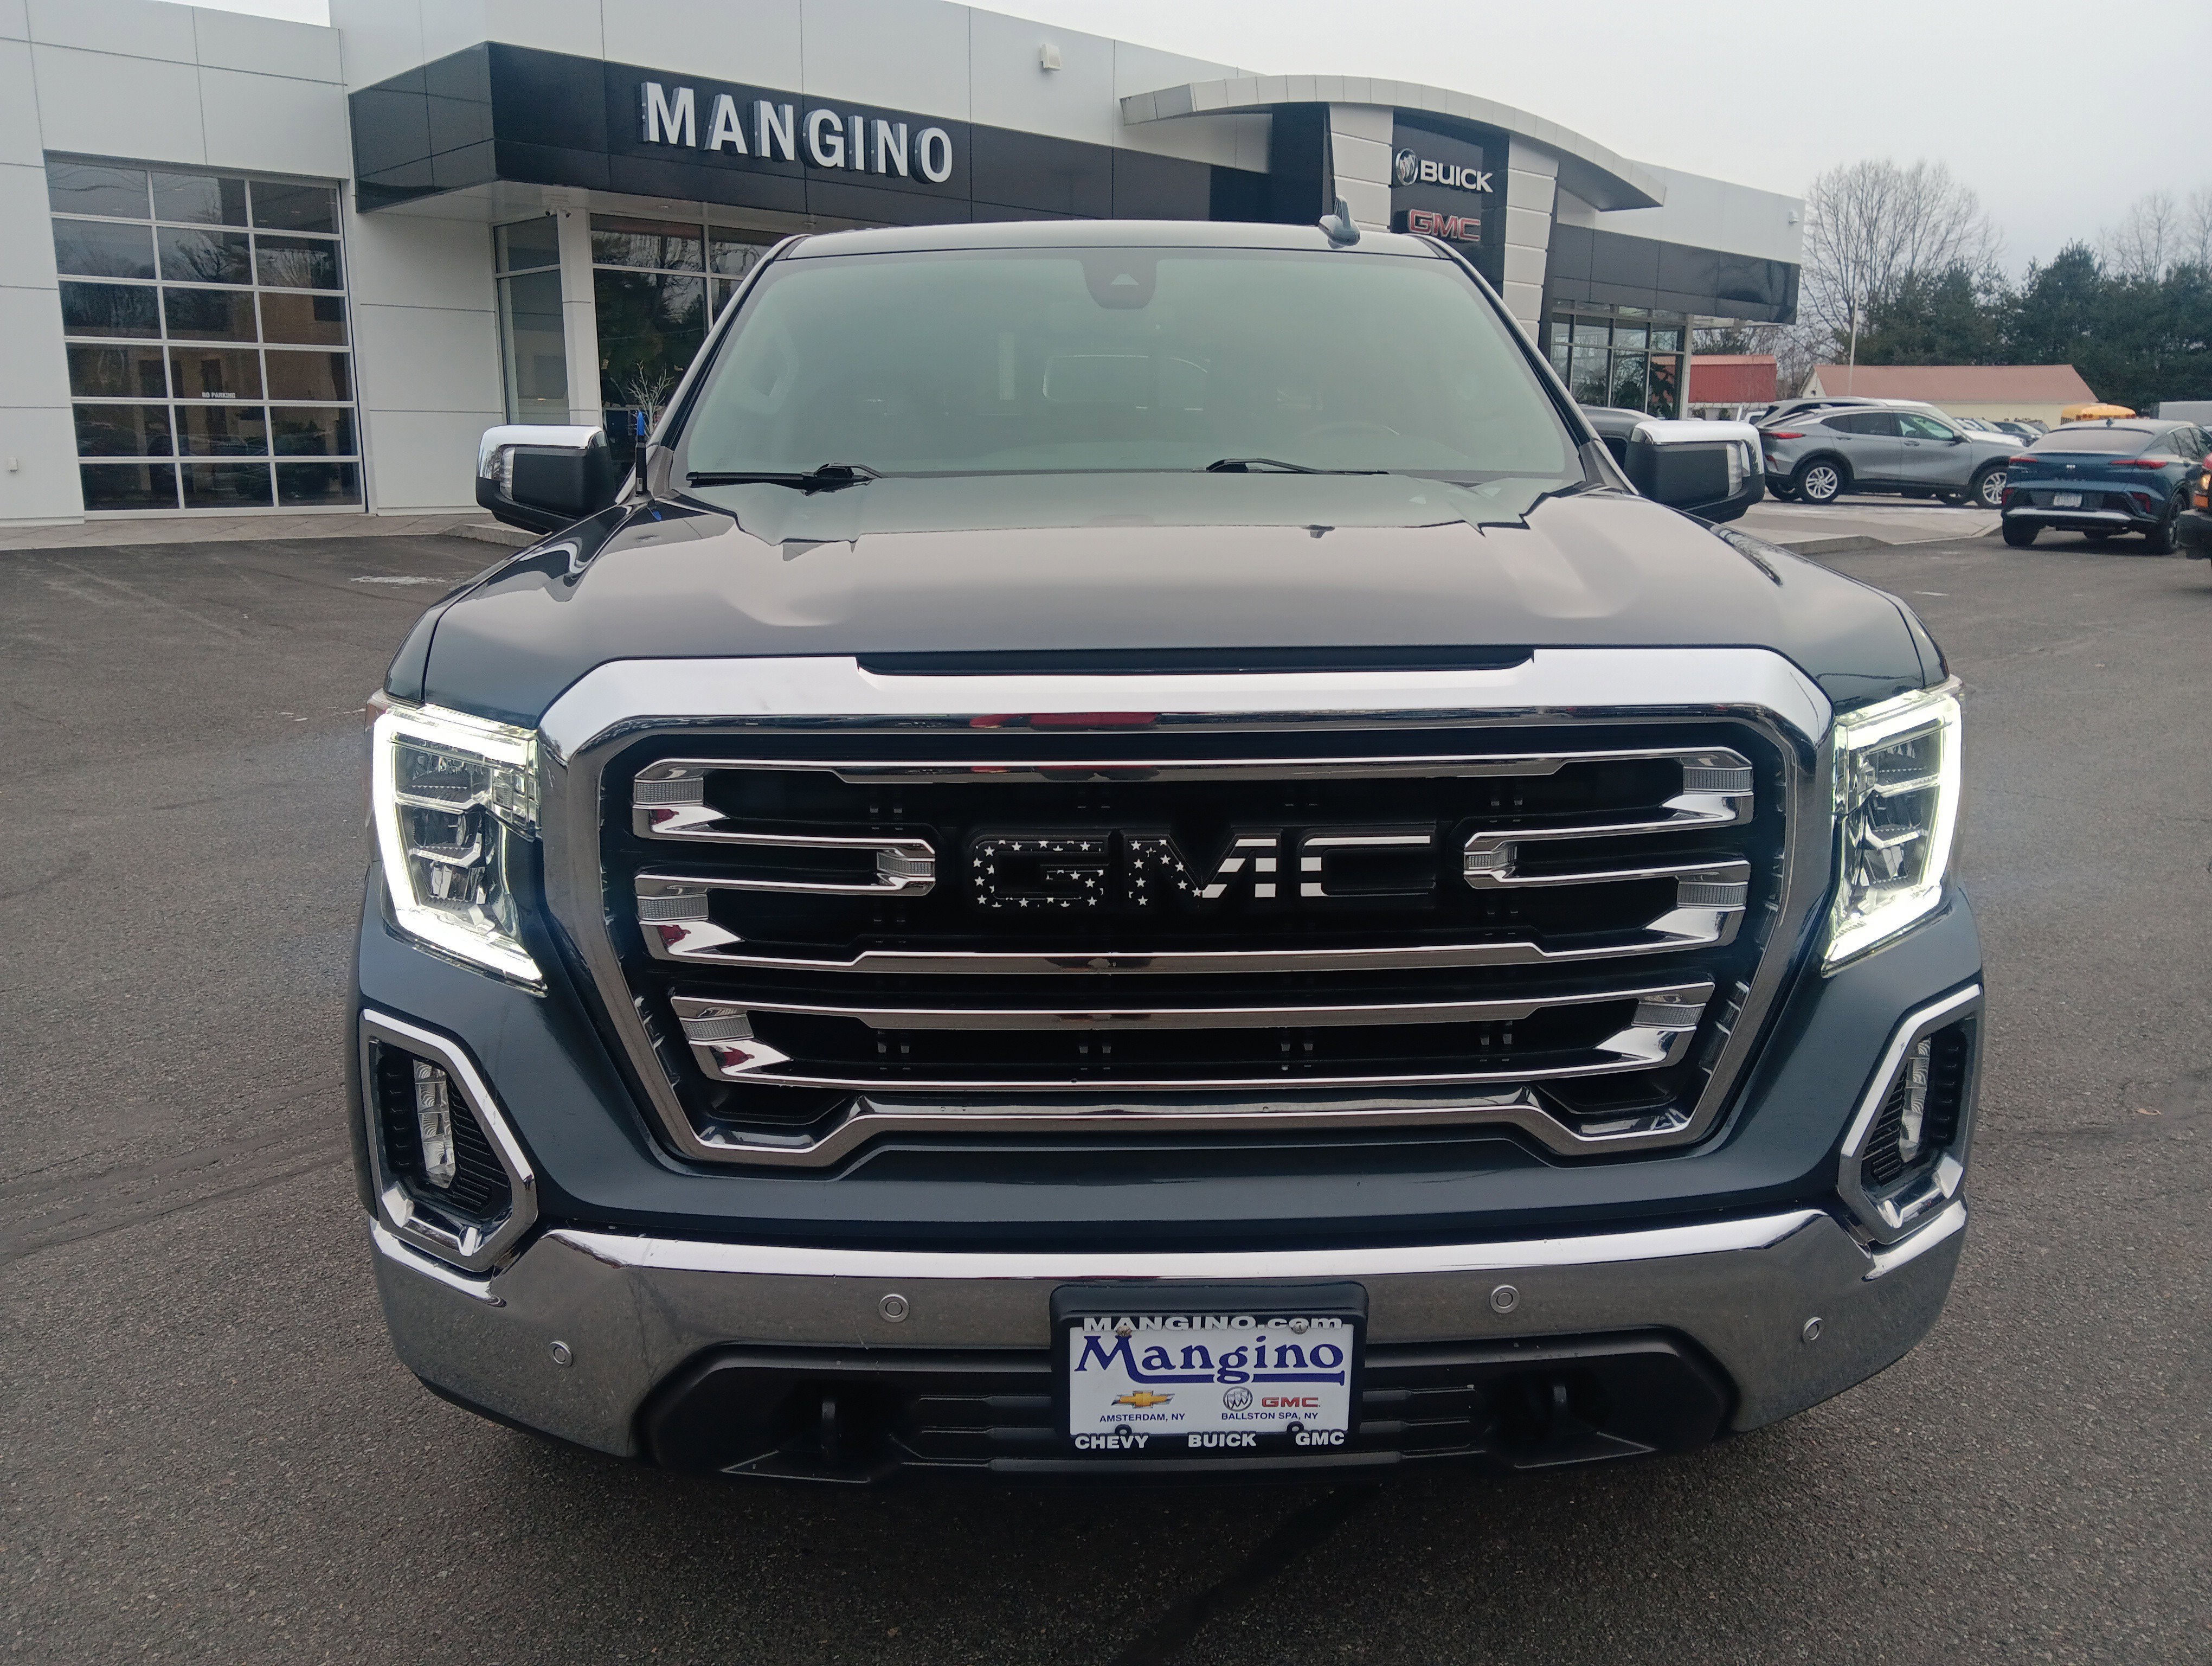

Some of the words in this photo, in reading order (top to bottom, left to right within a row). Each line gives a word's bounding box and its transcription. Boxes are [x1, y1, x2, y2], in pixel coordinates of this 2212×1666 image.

[640, 81, 953, 183] MANGINO
[1420, 159, 1493, 193] BUICK
[1409, 209, 1481, 241] GMC
[972, 830, 1435, 908] GMC
[1074, 1335, 1345, 1386] Mangino
[1099, 1413, 1168, 1422] AMSTERDAM,
[1221, 1412, 1275, 1420] BALLSTON
[1278, 1412, 1301, 1420] SPA,
[1262, 1397, 1319, 1408] GMC
[1075, 1435, 1149, 1449] CHEVY
[1188, 1433, 1257, 1447] BUICK
[1295, 1432, 1345, 1446] GMC
